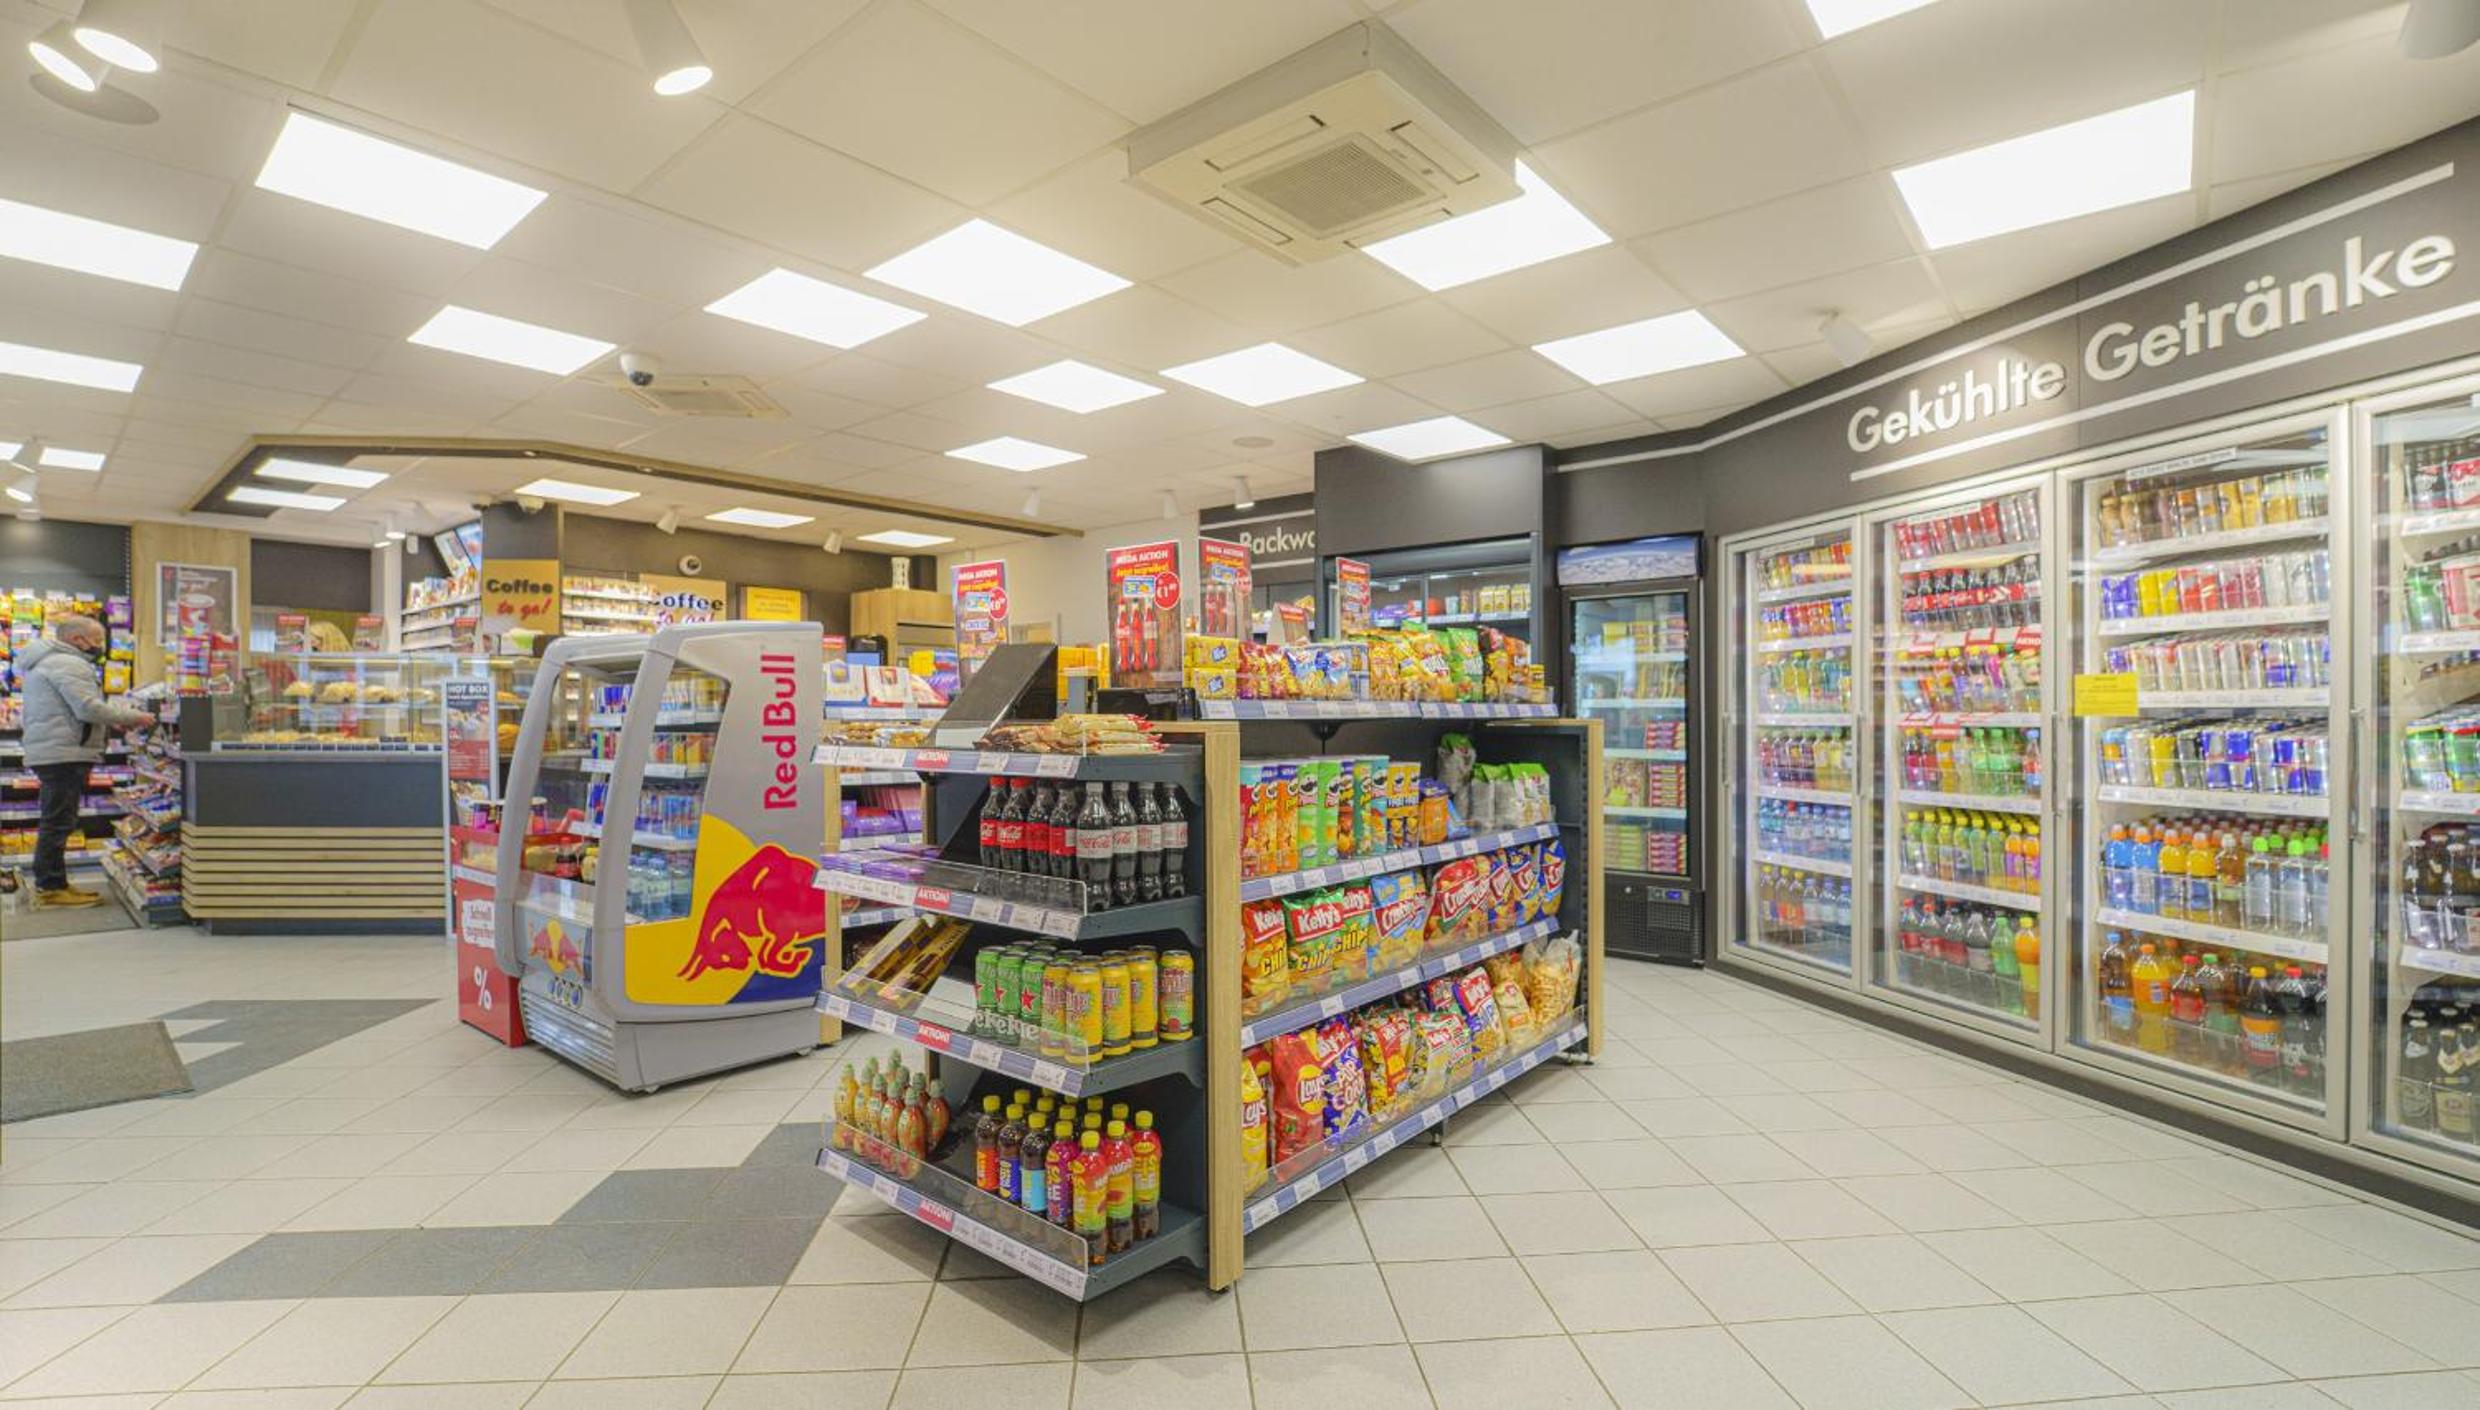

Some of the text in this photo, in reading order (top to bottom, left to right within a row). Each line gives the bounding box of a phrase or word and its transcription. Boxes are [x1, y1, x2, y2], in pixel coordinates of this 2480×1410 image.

[1848, 234, 2456, 453] Gekühlte Getränke
[486, 578, 554, 593] Coffee
[496, 595, 552, 621] to go!
[760, 654, 797, 810] Red Bull
[1297, 903, 1341, 934] Kelly's
